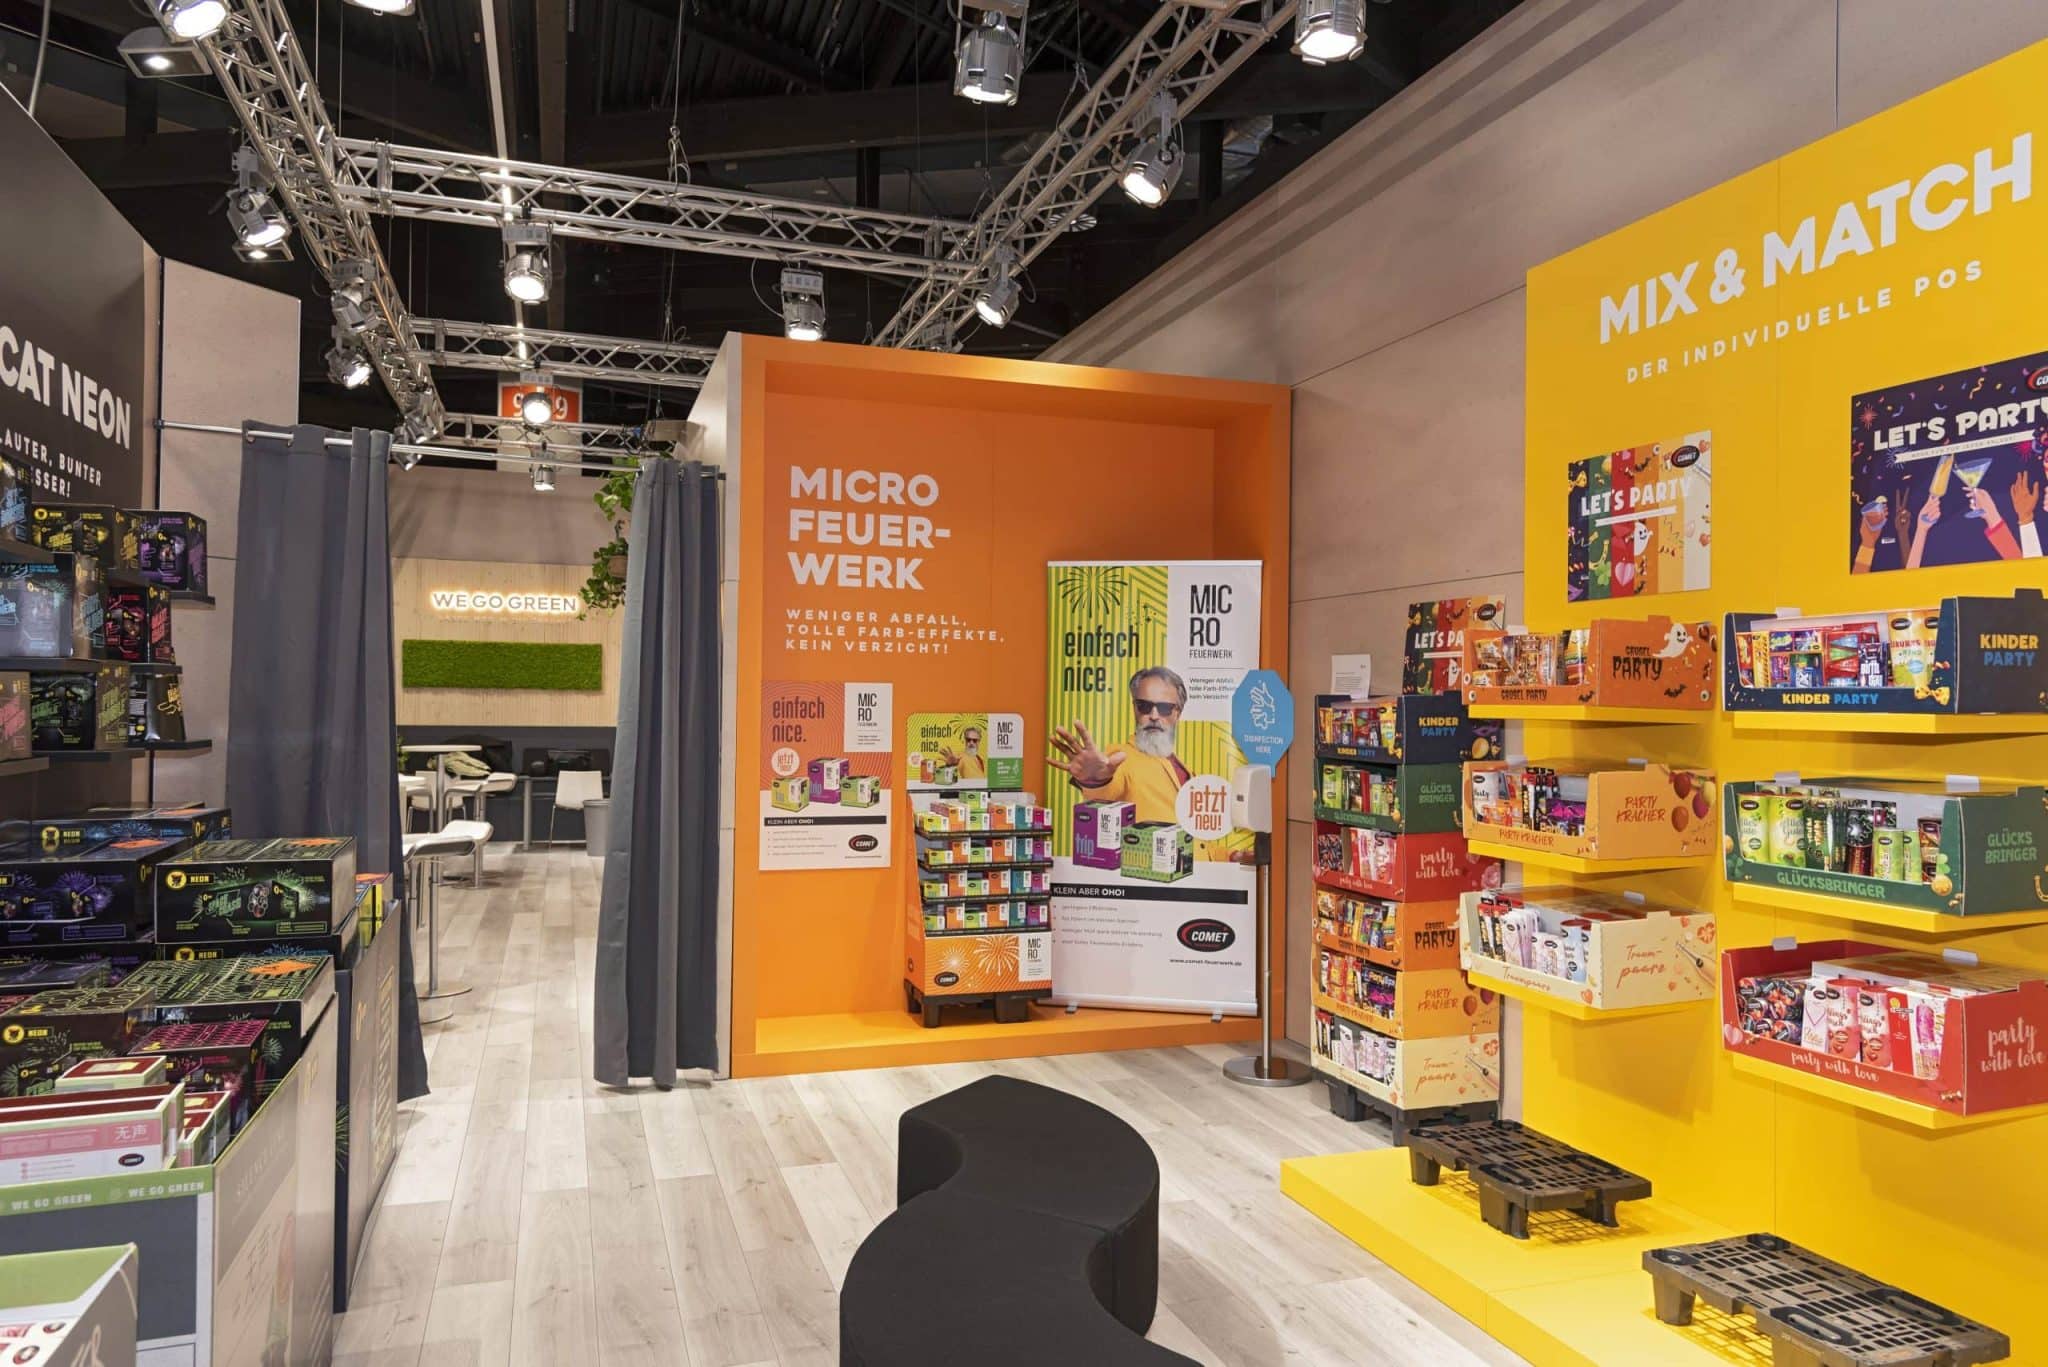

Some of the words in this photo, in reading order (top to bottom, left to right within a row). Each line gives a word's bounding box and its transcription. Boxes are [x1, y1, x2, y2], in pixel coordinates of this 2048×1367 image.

[1600, 261, 1699, 344] MIX
[1709, 248, 1746, 305] &
[1763, 132, 2032, 289] MATCH
[1626, 358, 1669, 384] DER
[1683, 288, 1892, 367] INDIVIDUELLE
[1914, 260, 1983, 297] POS
[61, 362, 131, 450] NEON
[1874, 416, 1945, 451] LET'S
[0, 428, 52, 467] AUTER,
[59, 453, 101, 487] BUNTER
[790, 465, 940, 507] MICRO
[1581, 488, 1625, 517] LET'S
[1629, 477, 1691, 508] PARTY
[789, 509, 951, 549] FEUER-
[787, 552, 925, 590] WERK
[433, 593, 467, 608] WE
[472, 595, 503, 609] GO
[508, 597, 577, 612] GREEN
[1189, 584, 1233, 614] MIC
[786, 609, 879, 623] WENIGER
[889, 613, 967, 626] ABFALL,
[786, 624, 846, 636] TOLLE
[858, 627, 1005, 643] FARB-EFFEKTE,
[1189, 617, 1221, 647] RO
[1415, 631, 1444, 648] LET'S
[785, 639, 831, 650] KEIN
[845, 641, 949, 654] VERZICHT!
[1064, 625, 1140, 658] einfach
[1980, 634, 2039, 649] KINDER
[1189, 650, 1233, 659] FEUERWERK
[1625, 646, 1651, 656] GRUSEL
[1983, 652, 2036, 666] PARTY
[1612, 656, 1663, 681] PARTY
[1064, 664, 1113, 692] nice.
[858, 693, 877, 707] MIC
[1526, 689, 1548, 701] PARTY
[1782, 693, 1830, 705] KINDER
[1834, 693, 1879, 705] PARTY
[772, 696, 825, 719] einfach
[858, 708, 872, 721] RO
[1418, 716, 1459, 727] KINDER
[772, 721, 807, 743] nice.
[921, 724, 952, 738] einfach
[1421, 727, 1457, 737] PARTY
[1420, 782, 1452, 793] GLÜCKS
[1188, 785, 1228, 818] jetzt
[1625, 796, 1658, 809] PARTY
[1194, 813, 1222, 832] neu!
[1616, 809, 1666, 824] KRACHER
[1987, 828, 2033, 847] GLÜCKS
[1420, 848, 1456, 865] party
[1985, 848, 2038, 864] BRINGER
[1441, 865, 1461, 878] love
[1053, 887, 1077, 895] KLEIN
[1078, 888, 1100, 896] ABER
[1101, 888, 1126, 897] OHO!
[1777, 871, 1886, 899] GLÜCKSBRINGER
[1191, 931, 1229, 943] COMET
[1415, 929, 1457, 949] PARTY
[28, 1029, 48, 1037] NEON
[1988, 1017, 2036, 1057] party
[1792, 1051, 1821, 1073] party
[1825, 1058, 1850, 1075] with
[1855, 1065, 1879, 1082] love
[1982, 1050, 2011, 1072] with
[2018, 1048, 2045, 1068] love
[114, 1124, 148, 1141] 无声
[128, 1187, 144, 1198] WE
[149, 1185, 164, 1195] GO
[168, 1182, 204, 1193] GREEN
[11, 1200, 29, 1211] WE
[34, 1197, 49, 1207] GO
[54, 1194, 92, 1206] GREEN
